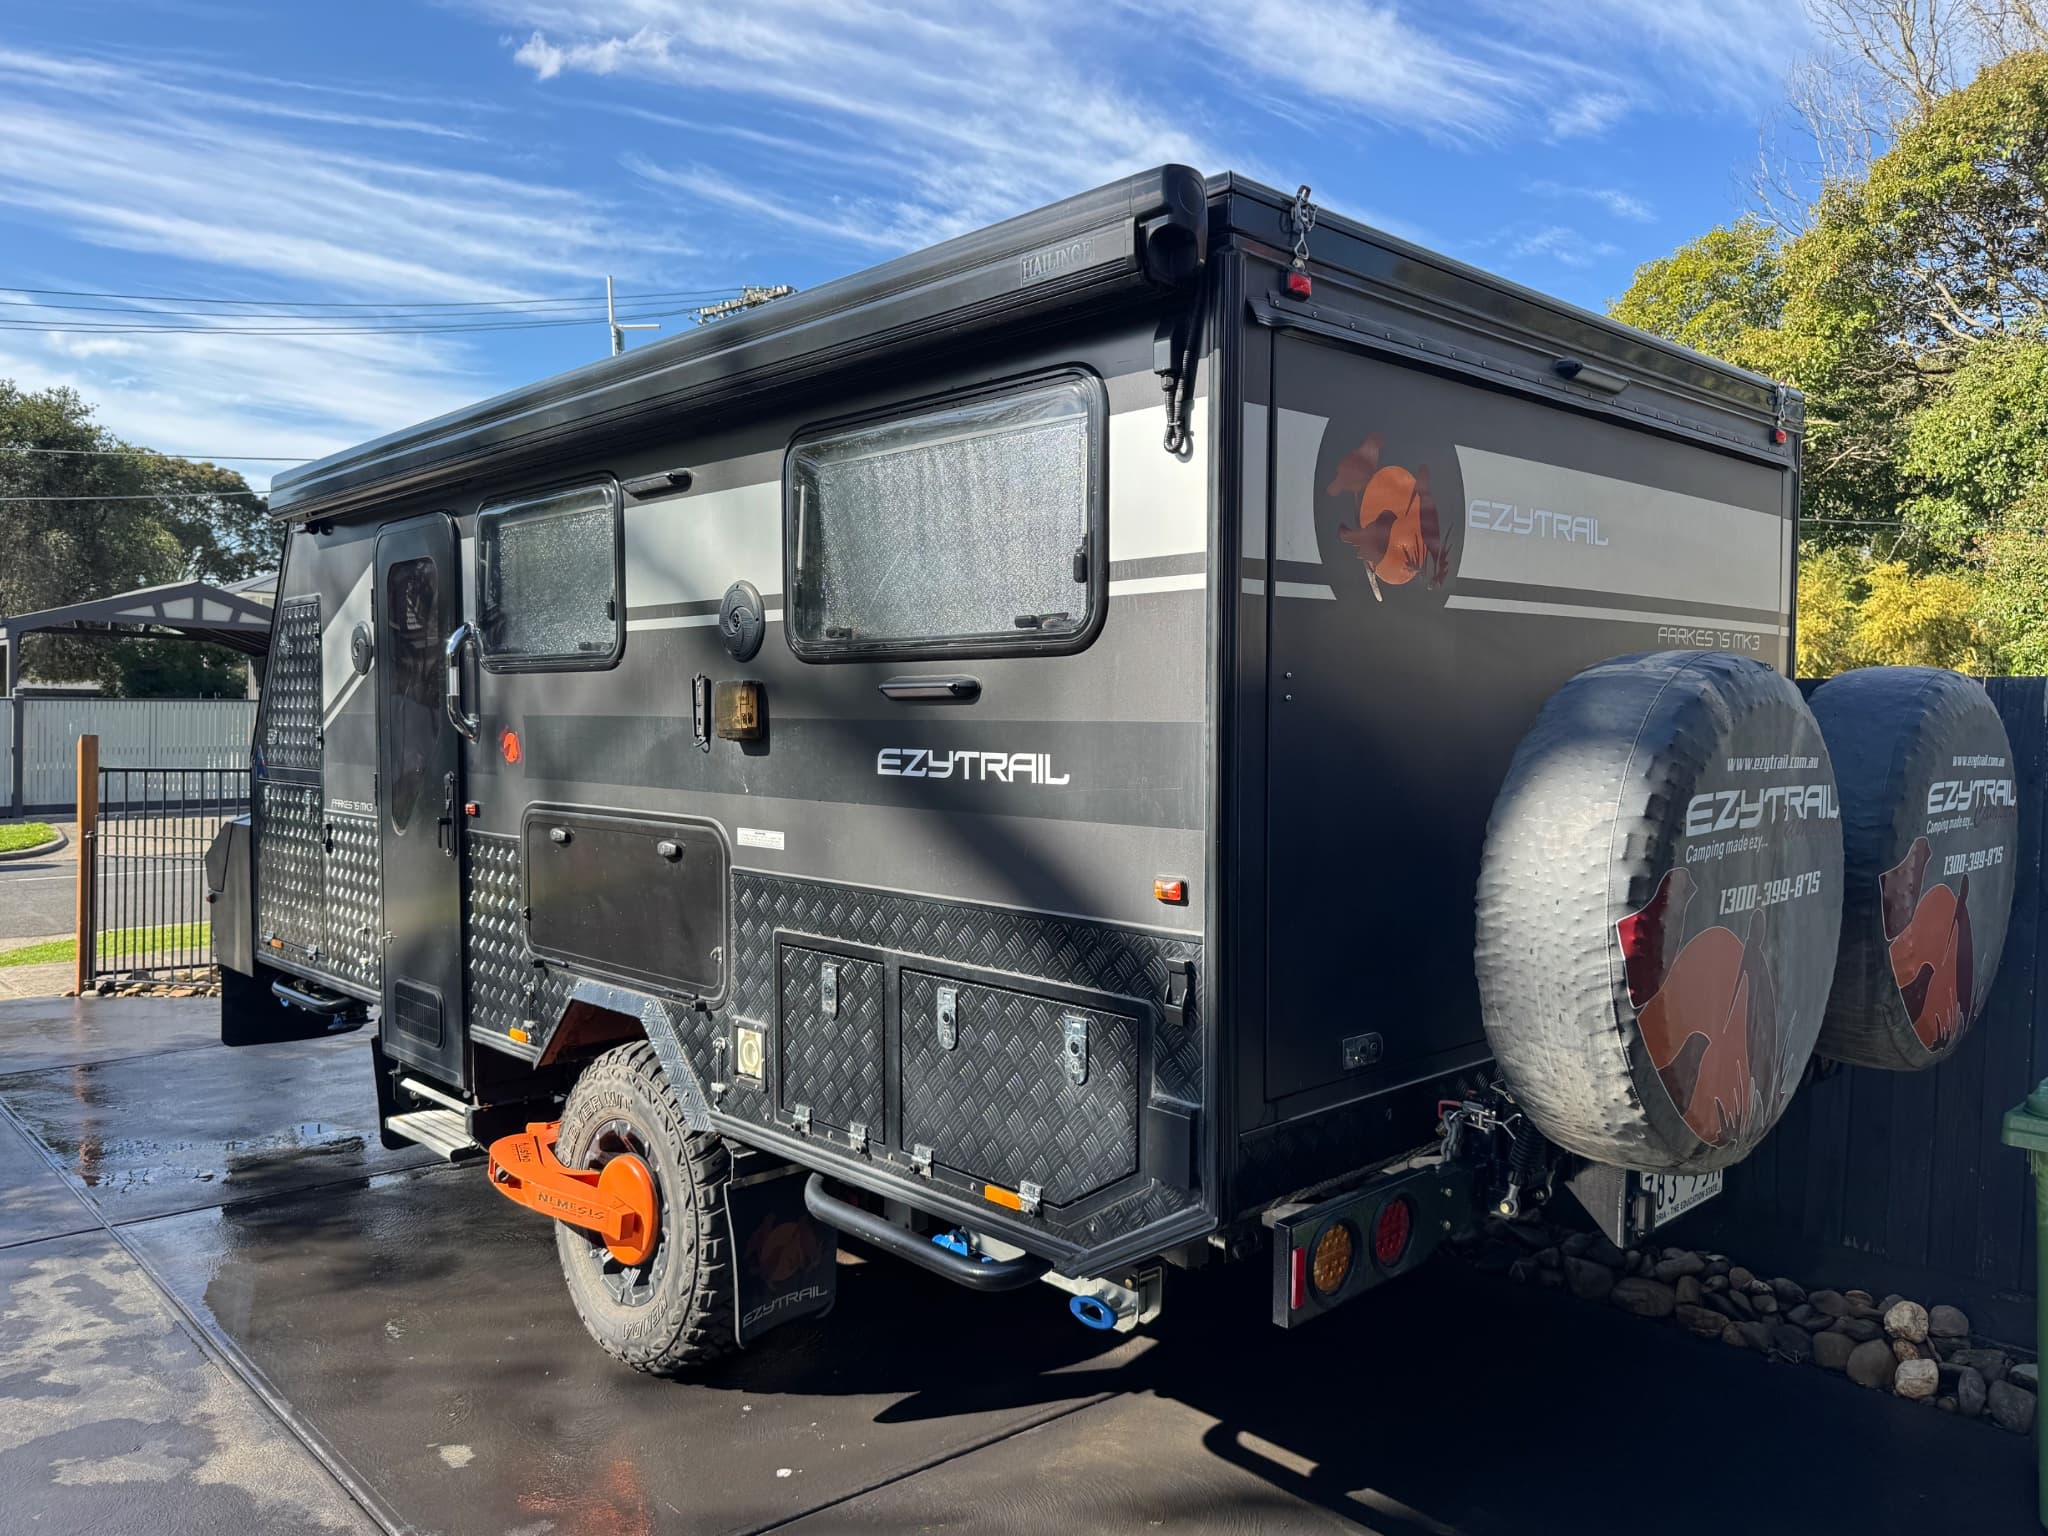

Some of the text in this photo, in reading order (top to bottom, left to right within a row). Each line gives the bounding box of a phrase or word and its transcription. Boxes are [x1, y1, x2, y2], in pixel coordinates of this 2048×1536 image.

[1469, 500, 1609, 546] EZYTRAIL
[1657, 626, 1713, 647] PARKES
[1733, 633, 1760, 651] MK3
[877, 748, 1070, 785] EZYTRAIL
[1727, 754, 1819, 773] www.ezytrail.com.au
[1686, 784, 1840, 837] EZYTRAIL
[1927, 779, 2017, 814] EZYTRAIL
[1685, 840, 1725, 864] Camping
[1725, 834, 1748, 855] made
[1943, 846, 2004, 876] 1300-399-875
[1719, 870, 1821, 915] 1300-399-875
[742, 1285, 828, 1329] EZYTRAIL
